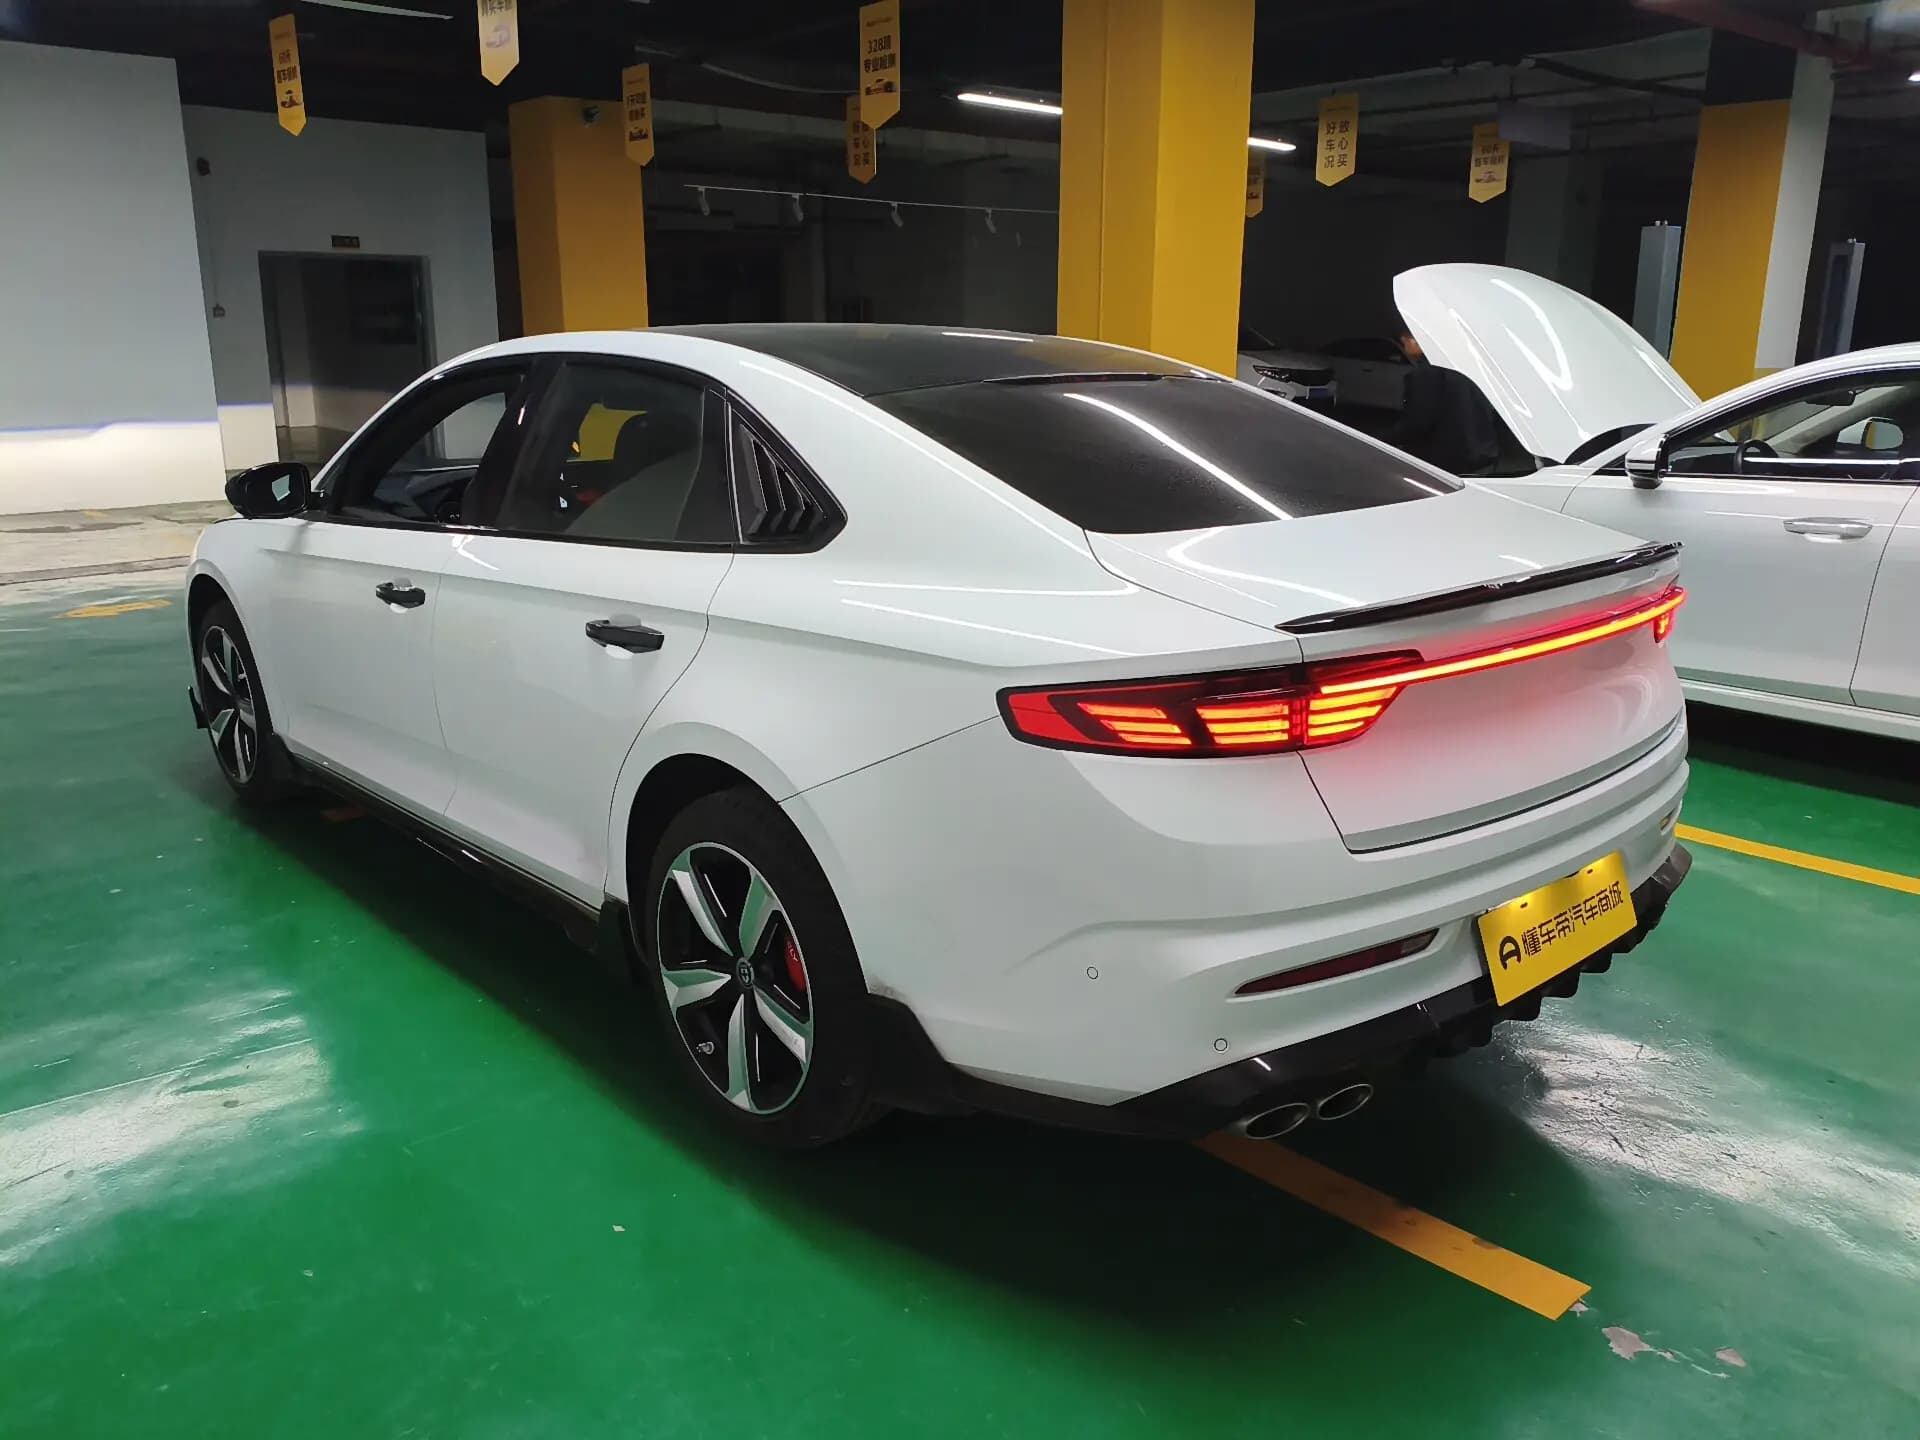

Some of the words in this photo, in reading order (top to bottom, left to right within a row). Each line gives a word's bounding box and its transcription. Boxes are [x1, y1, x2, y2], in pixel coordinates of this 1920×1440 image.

[1324, 121, 1337, 168] 好车况
[1337, 120, 1350, 167] 放心买
[1521, 880, 1624, 957] 懂车帝汽车商城
